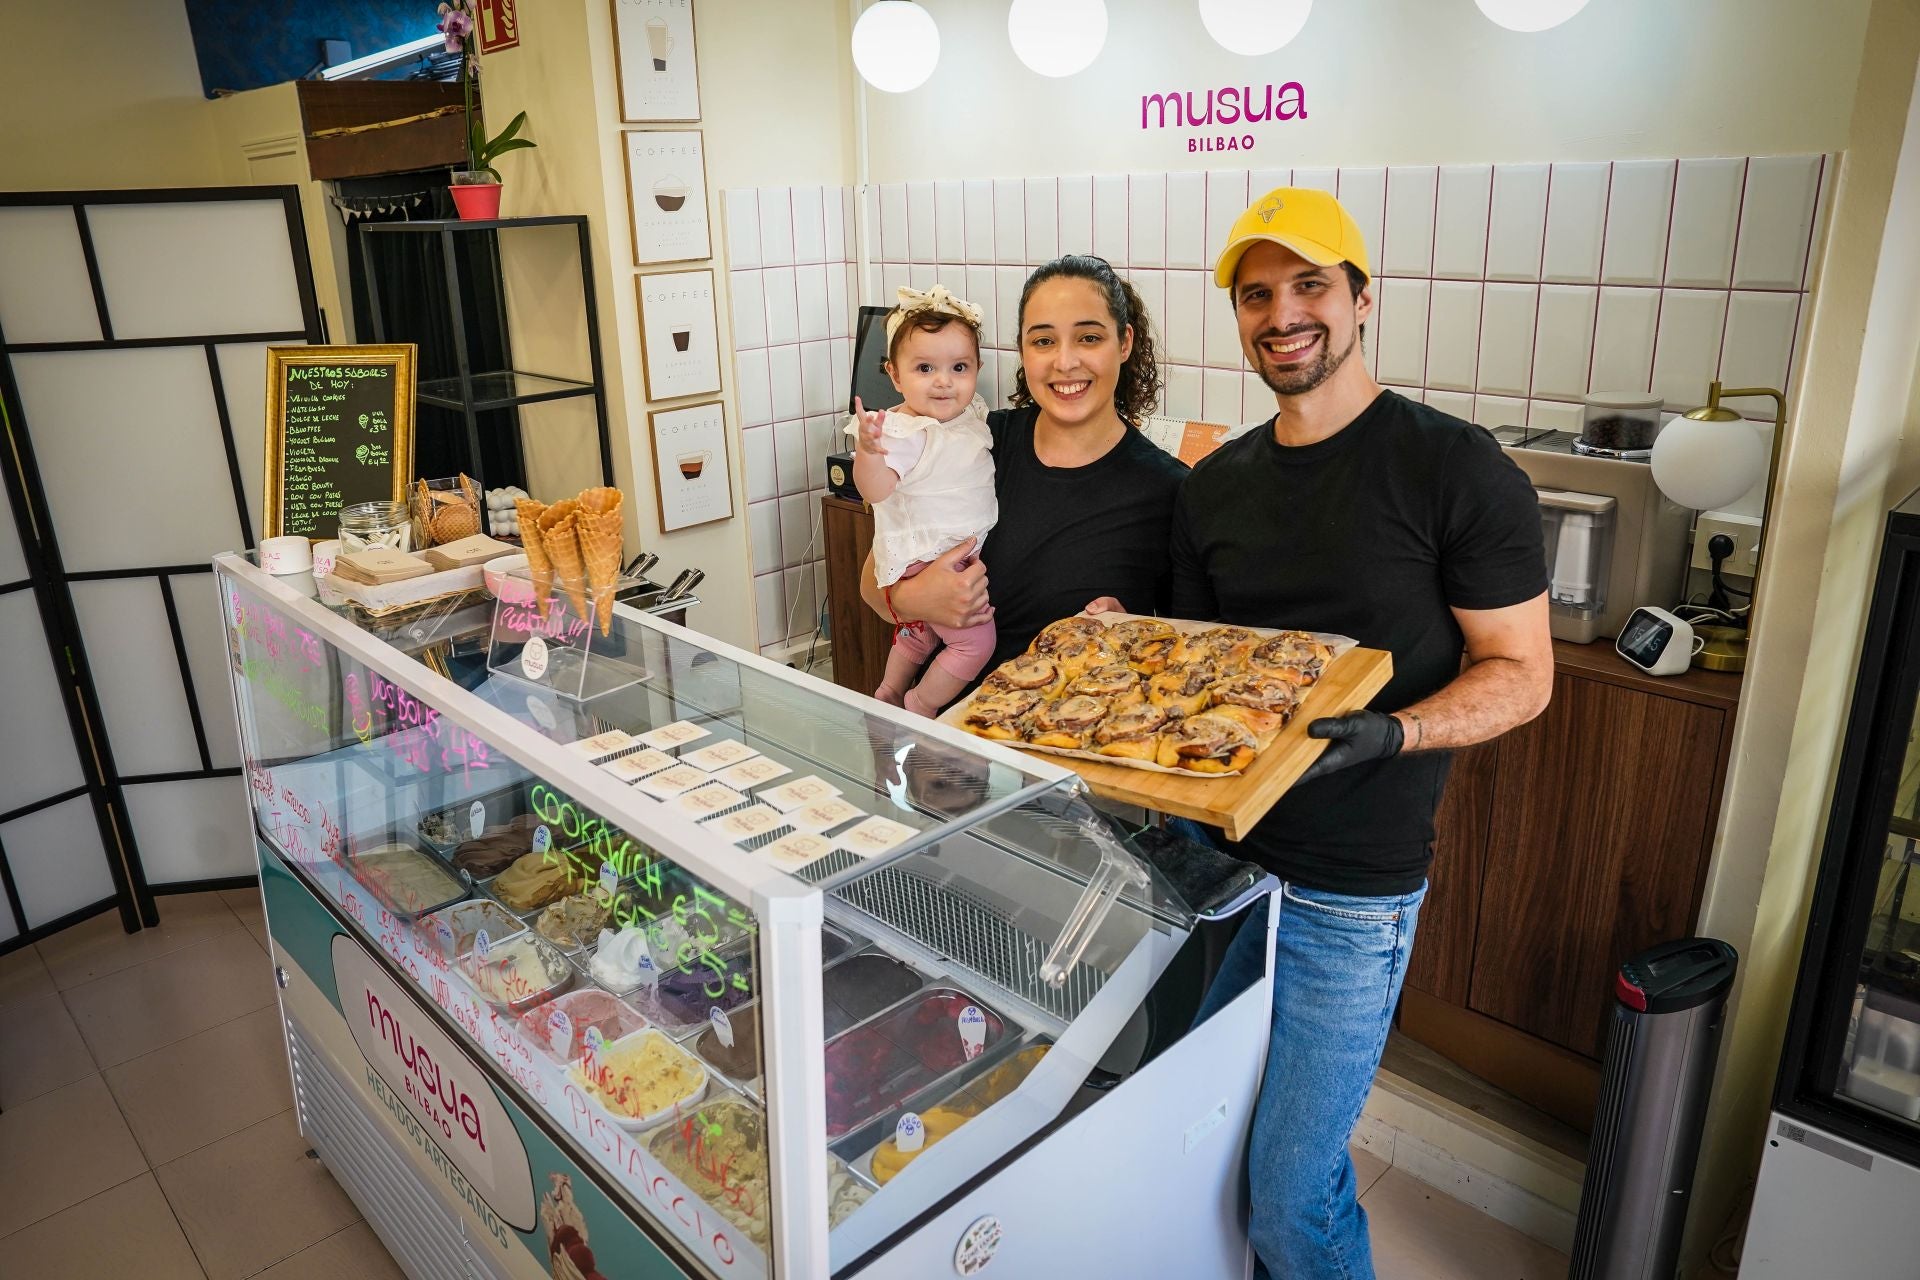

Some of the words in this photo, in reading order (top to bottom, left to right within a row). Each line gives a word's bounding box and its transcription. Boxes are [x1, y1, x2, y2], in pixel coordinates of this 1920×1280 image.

[1142, 82, 1307, 128] musua
[636, 147, 697, 157] COFFEE
[1188, 134, 1254, 152] BILBAO
[647, 289, 708, 303] COFFEE
[309, 381, 323, 390] DE
[661, 418, 718, 436] COFFEE
[366, 988, 486, 1153] musua
[404, 1074, 452, 1139] BILBAO
[365, 1066, 422, 1147] HELADOS
[423, 1141, 509, 1250] ARTESANOS
[564, 1084, 736, 1266] PISTACCIO
